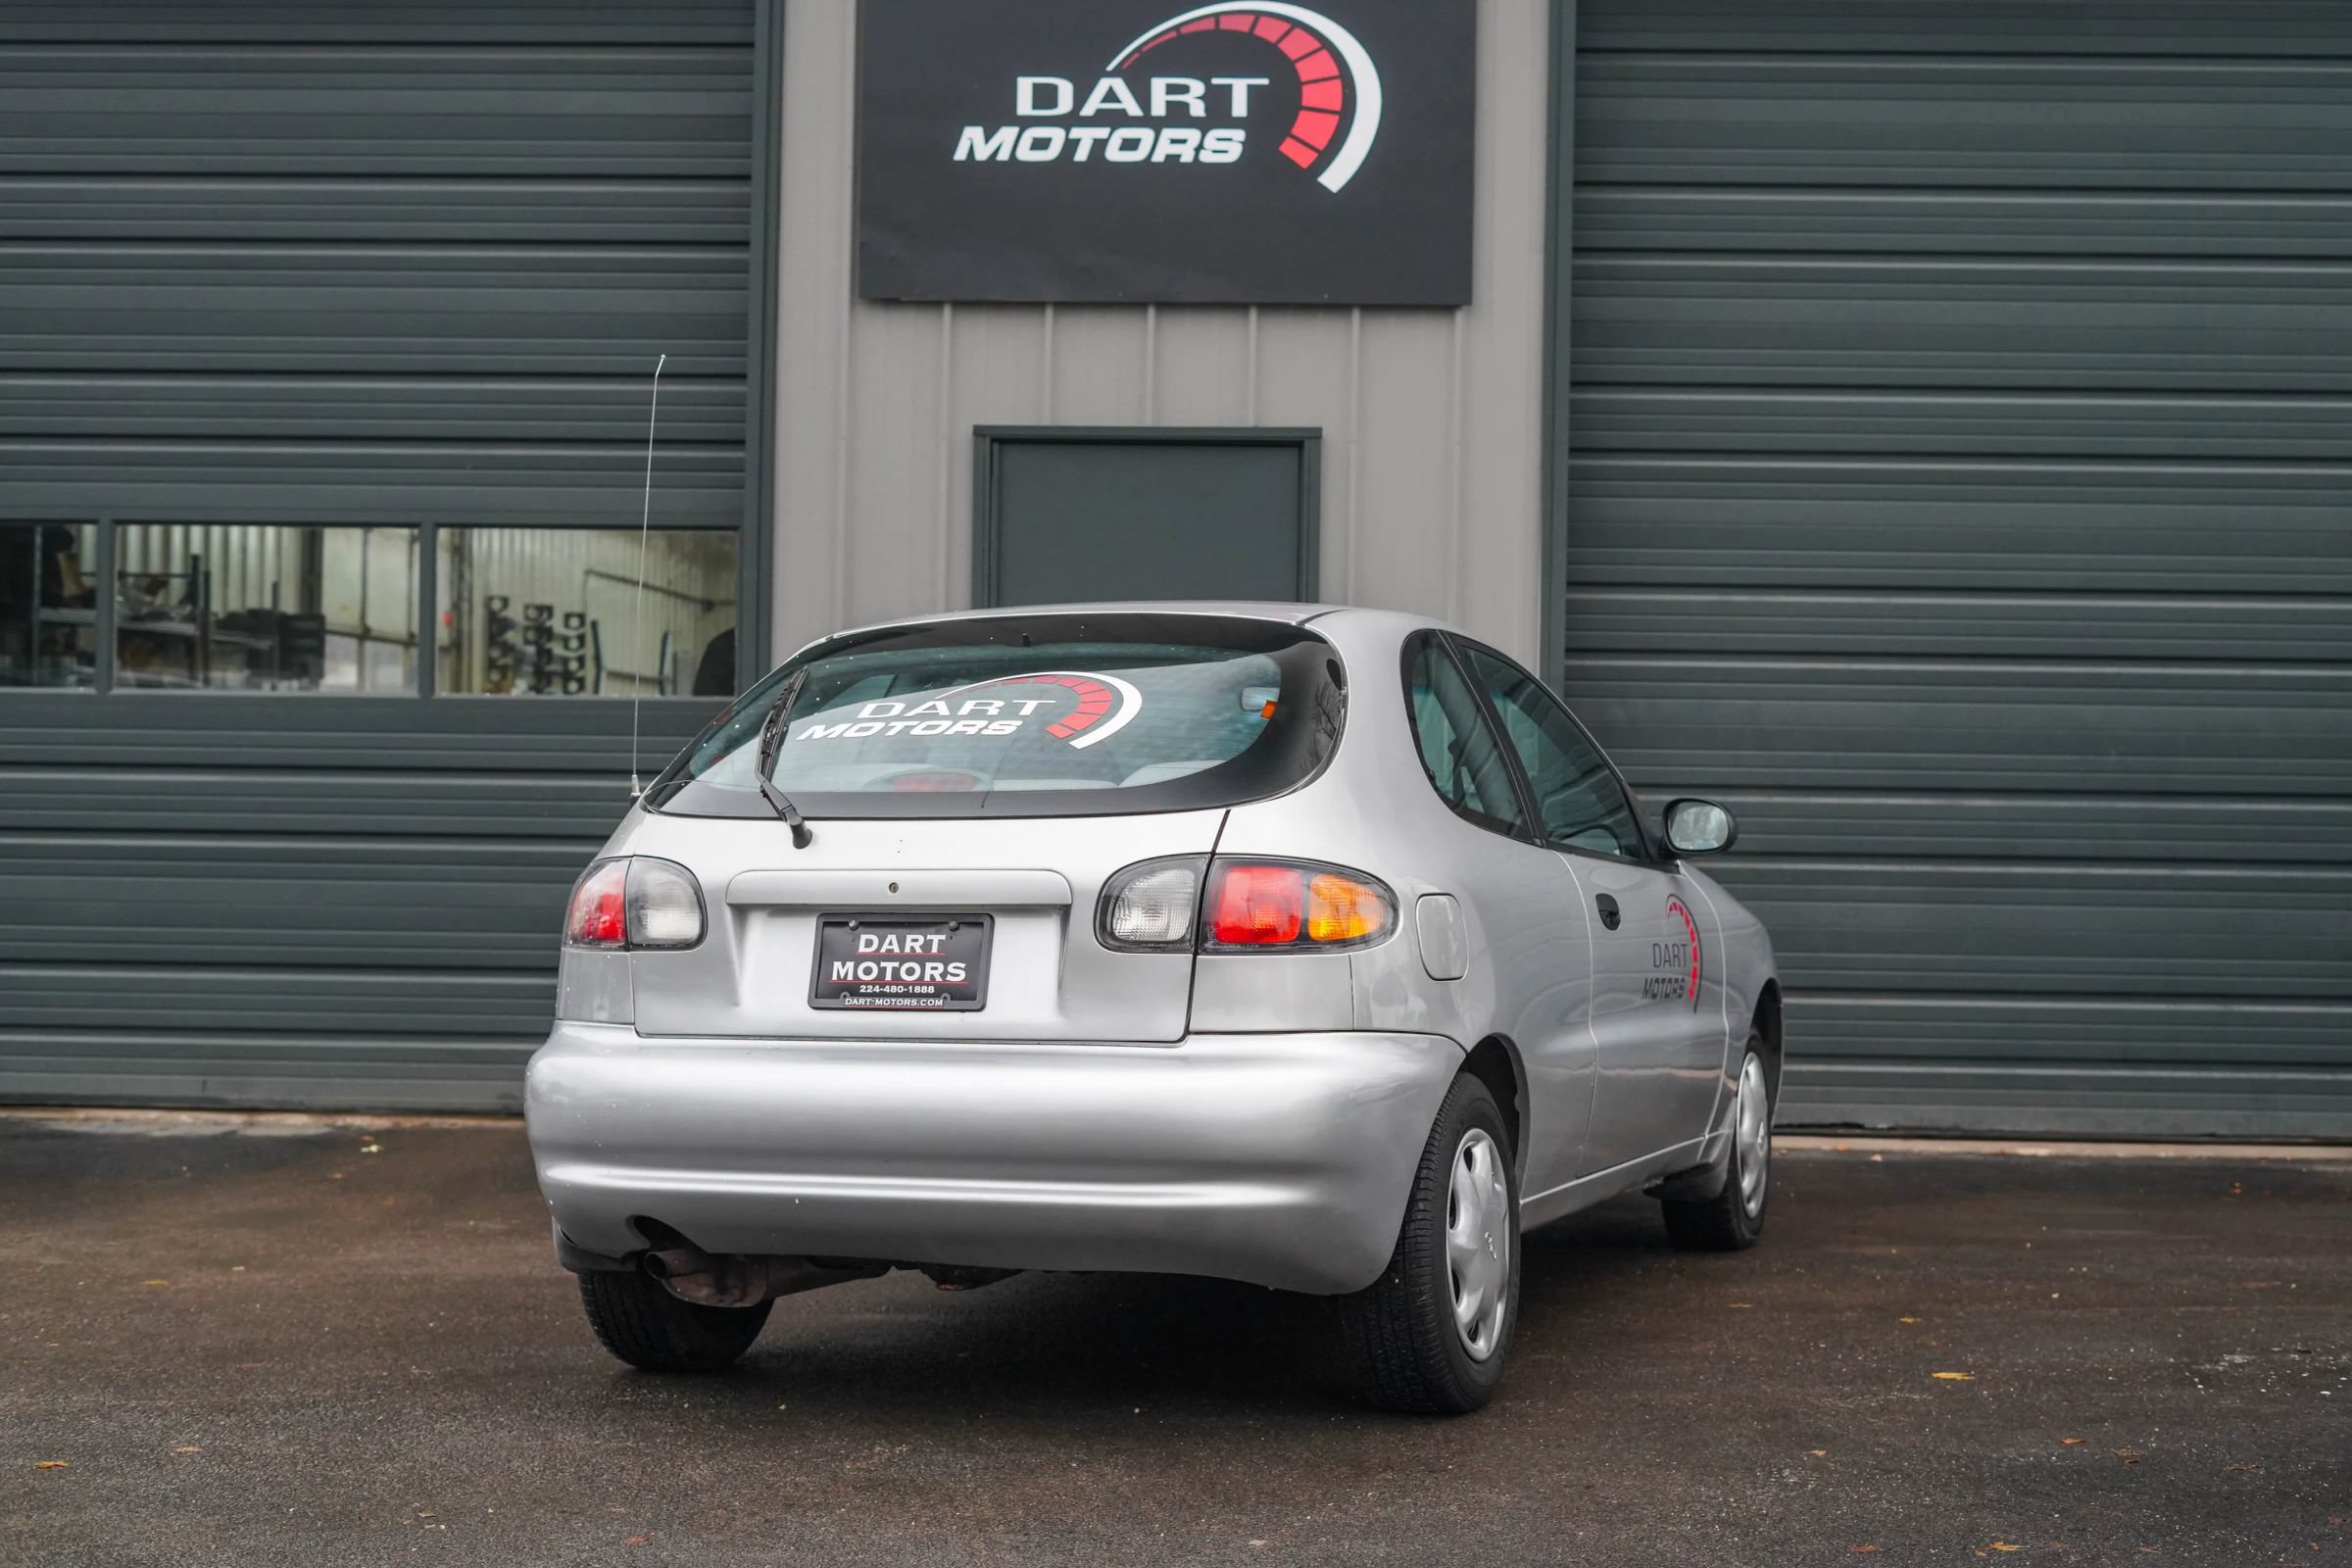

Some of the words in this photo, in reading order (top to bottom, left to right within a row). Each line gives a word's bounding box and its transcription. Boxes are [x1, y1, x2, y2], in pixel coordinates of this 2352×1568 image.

[1015, 75, 1270, 118] DART
[953, 125, 1247, 164] MOTORS
[856, 700, 1055, 718] DART
[795, 719, 1023, 741] MOTORS
[858, 934, 947, 954] DART
[1652, 943, 1688, 967] DART
[832, 960, 966, 982] MOTORS
[859, 985, 935, 994] 224-480-1888
[1642, 977, 1685, 1000] MOTORS
[845, 998, 944, 1006] DART-MOTORS.COM
